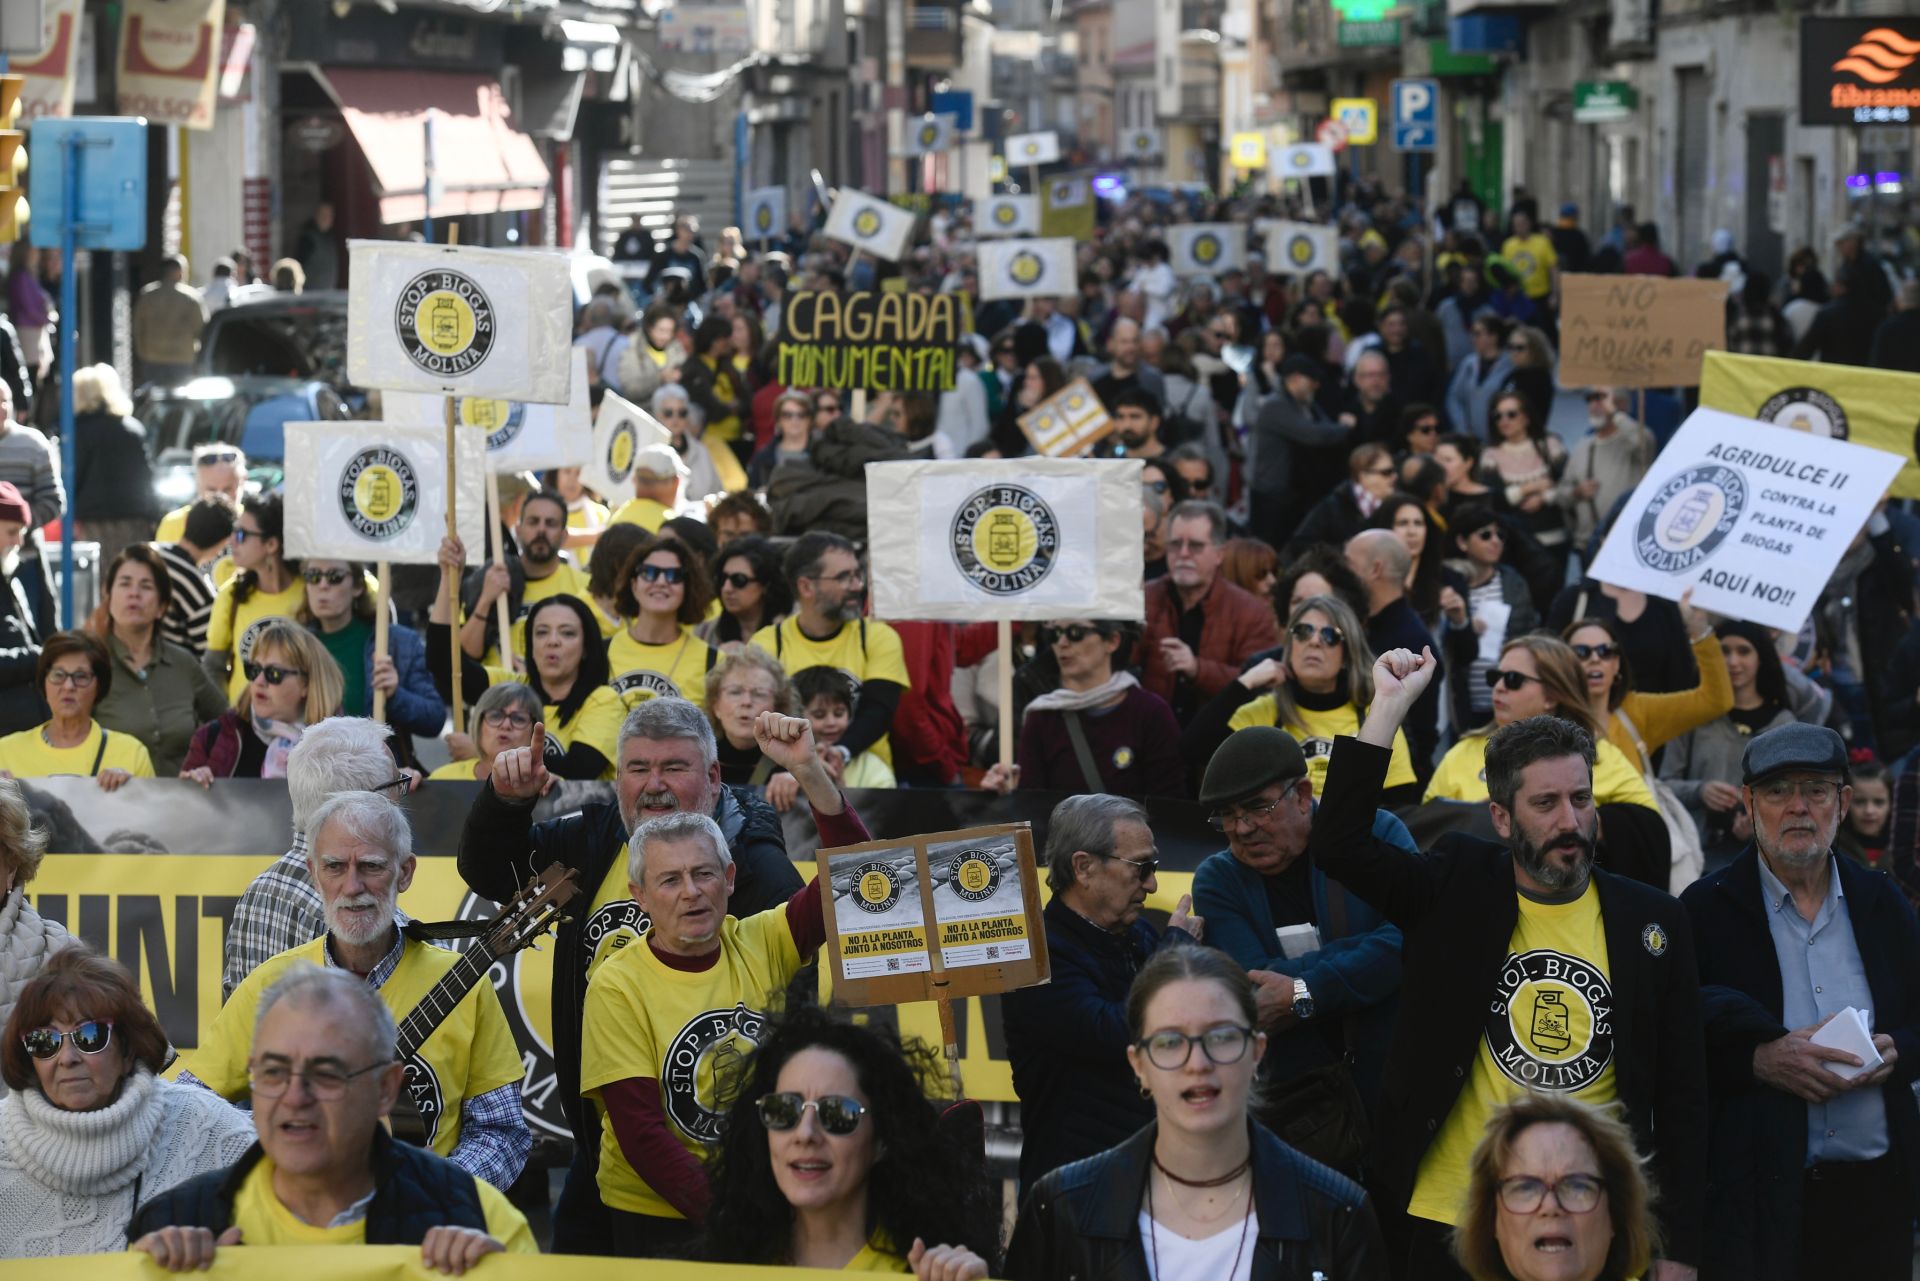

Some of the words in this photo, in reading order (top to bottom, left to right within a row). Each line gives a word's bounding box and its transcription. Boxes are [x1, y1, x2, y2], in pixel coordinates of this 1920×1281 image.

[400, 280, 428, 326] STOP
[442, 274, 491, 333] BIOGAS
[1606, 281, 1657, 311] NO
[786, 290, 955, 342] CAGADA
[413, 345, 483, 373] MOLINA
[1572, 335, 1674, 363] MOLINA
[777, 341, 957, 392] MONUMENTAL
[342, 456, 366, 498] STOP
[1706, 443, 1828, 486] AGRIDULCE
[1647, 470, 1698, 514] STOP
[1760, 489, 1816, 511] CONTRA
[1818, 503, 1837, 516] LA
[955, 497, 986, 545] STOP
[1000, 490, 1054, 546] BIOGAS
[1750, 512, 1804, 533] PLANTA
[1806, 525, 1827, 540] DE
[1740, 533, 1794, 555] BIOGAS
[969, 563, 1044, 590] MOLINA
[1699, 568, 1753, 594] AQUÍ
[1752, 581, 1796, 607] NO!!
[852, 868, 864, 892] STOP
[951, 857, 962, 880] STOP
[860, 897, 896, 911] MOLINA
[960, 885, 996, 899] MOLINA
[848, 935, 860, 945] NO
[862, 935, 868, 944] A
[870, 934, 880, 943] LA
[882, 930, 914, 942] PLANTA
[943, 932, 969, 944] JUNTO
[972, 932, 978, 941] A
[980, 926, 1024, 939] NOSOTROS
[947, 924, 959, 934] NO
[961, 923, 967, 932] A
[969, 922, 980, 931] LA
[982, 918, 1014, 930] PLANTA
[843, 943, 870, 955] JUNTO
[872, 943, 878, 952] A
[880, 938, 923, 951] NOSOTROS
[672, 1033, 701, 1093] STOP
[1499, 1042, 1600, 1086] MOLINA
